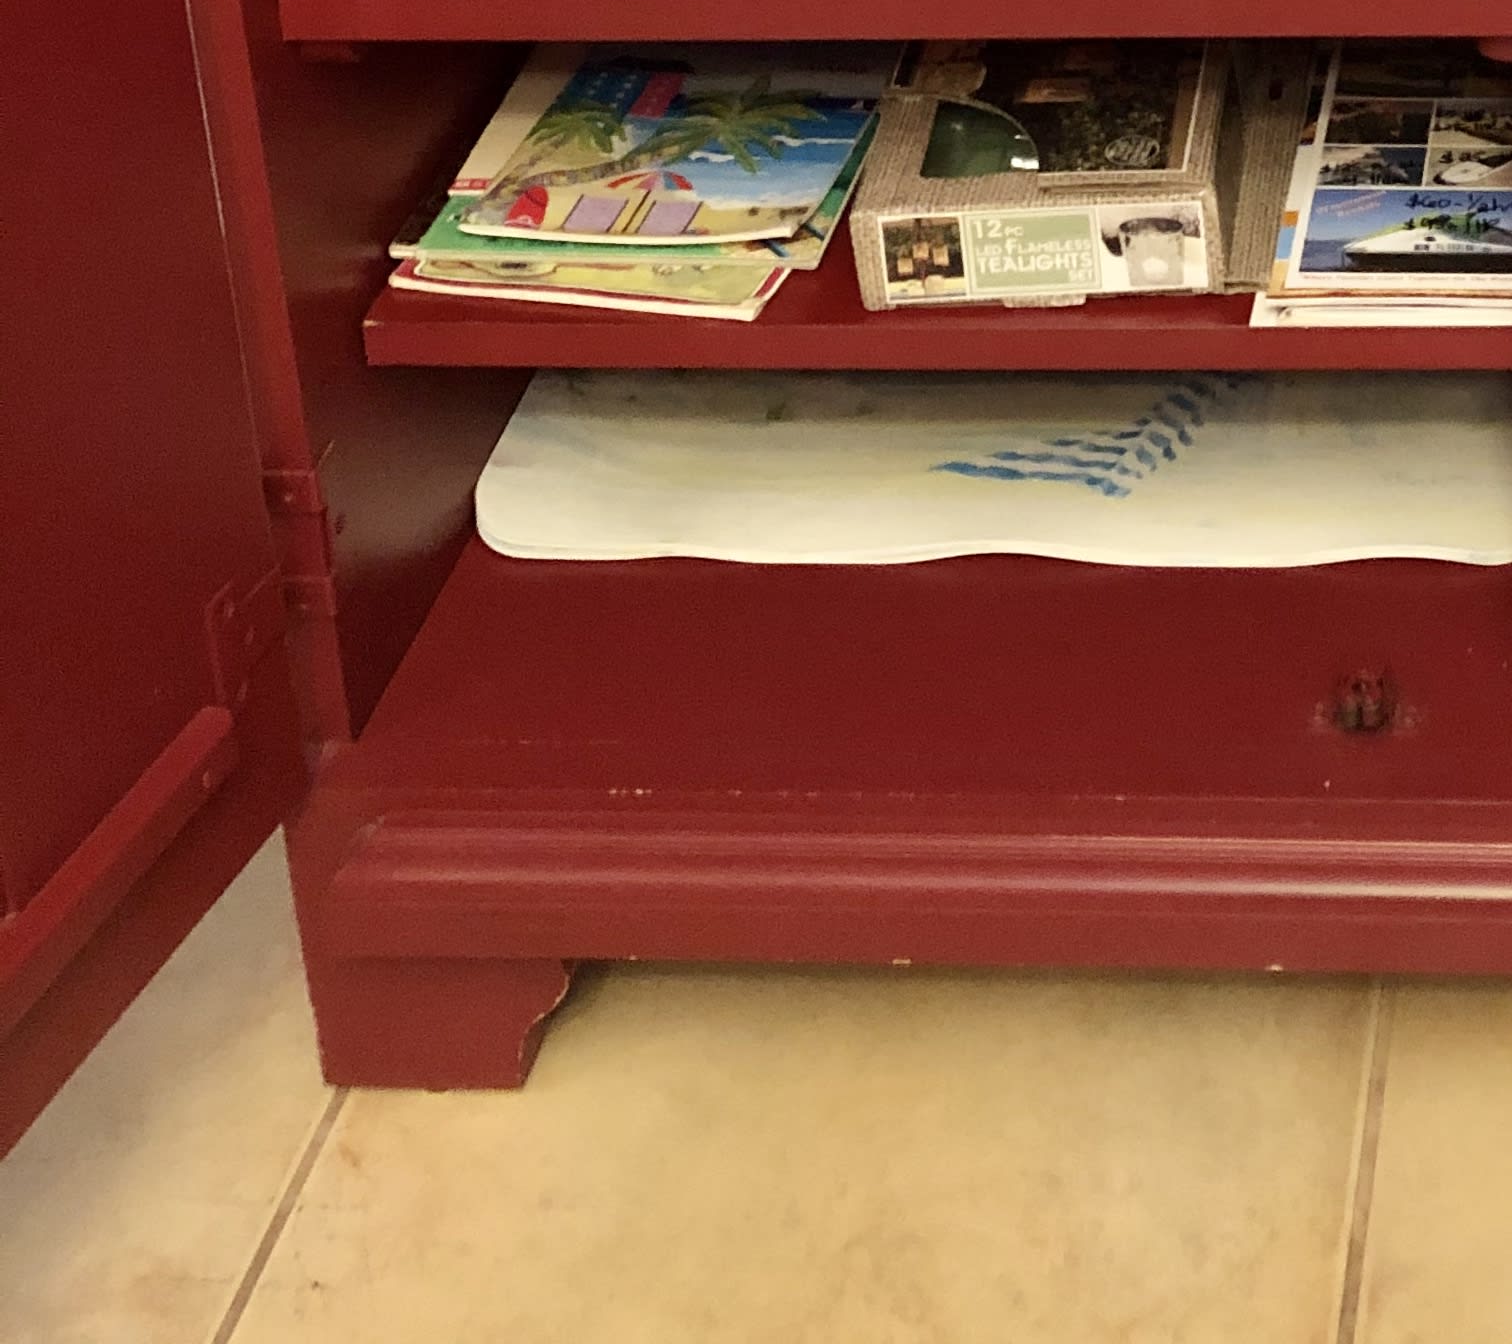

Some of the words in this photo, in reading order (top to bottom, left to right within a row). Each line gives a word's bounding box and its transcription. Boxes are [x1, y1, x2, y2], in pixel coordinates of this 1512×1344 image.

[972, 219, 1004, 239] 12
[1004, 225, 1024, 237] PC
[975, 242, 1003, 255] LED
[1005, 236, 1092, 255] FLAMELESS
[977, 252, 1094, 275] TEALIGHTS
[1068, 268, 1095, 282] SET
